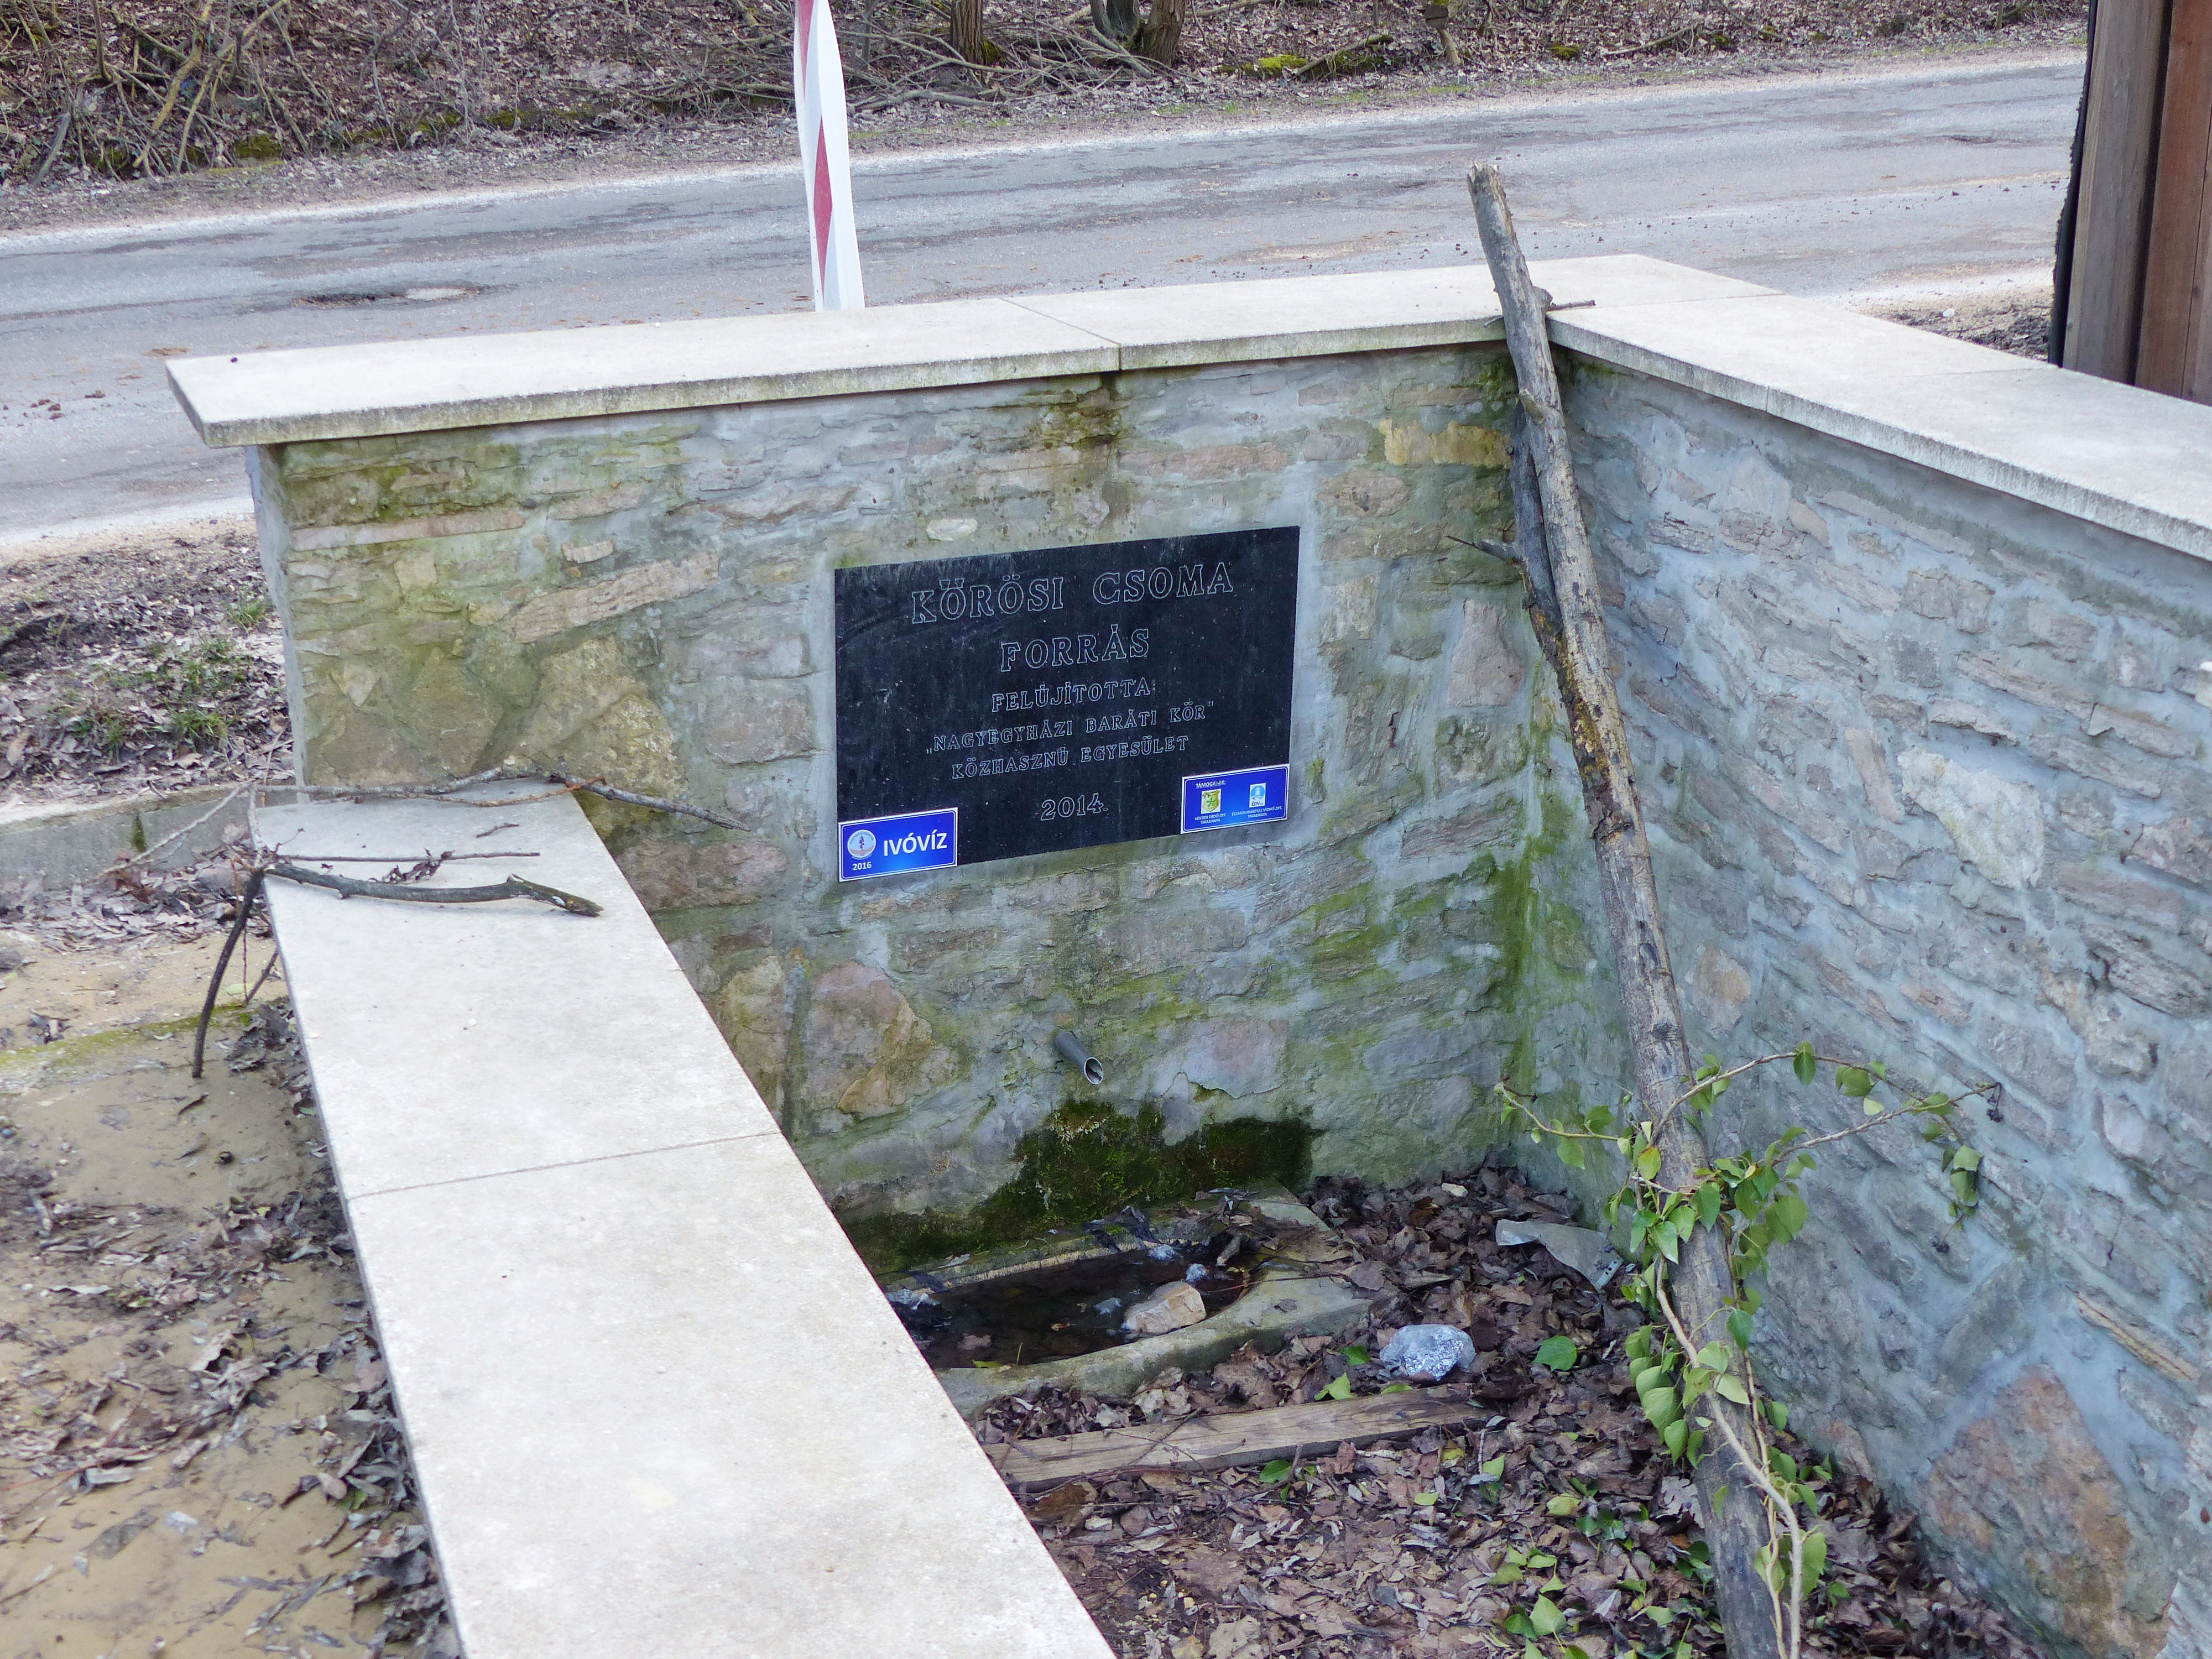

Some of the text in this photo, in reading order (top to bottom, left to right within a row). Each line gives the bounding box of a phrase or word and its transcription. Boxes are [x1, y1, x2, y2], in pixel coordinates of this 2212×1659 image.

[1092, 562, 1234, 605] CSOMA
[1000, 624, 1149, 672] FORRÁS
[1086, 709, 1157, 733] BARÁTI
[951, 735, 1189, 780] KÖZHASZNÚ EGYESÜLET
[1040, 792, 1109, 821] 2014.
[884, 829, 947, 857] IVÓVÍZ
[852, 861, 872, 871] 2016
